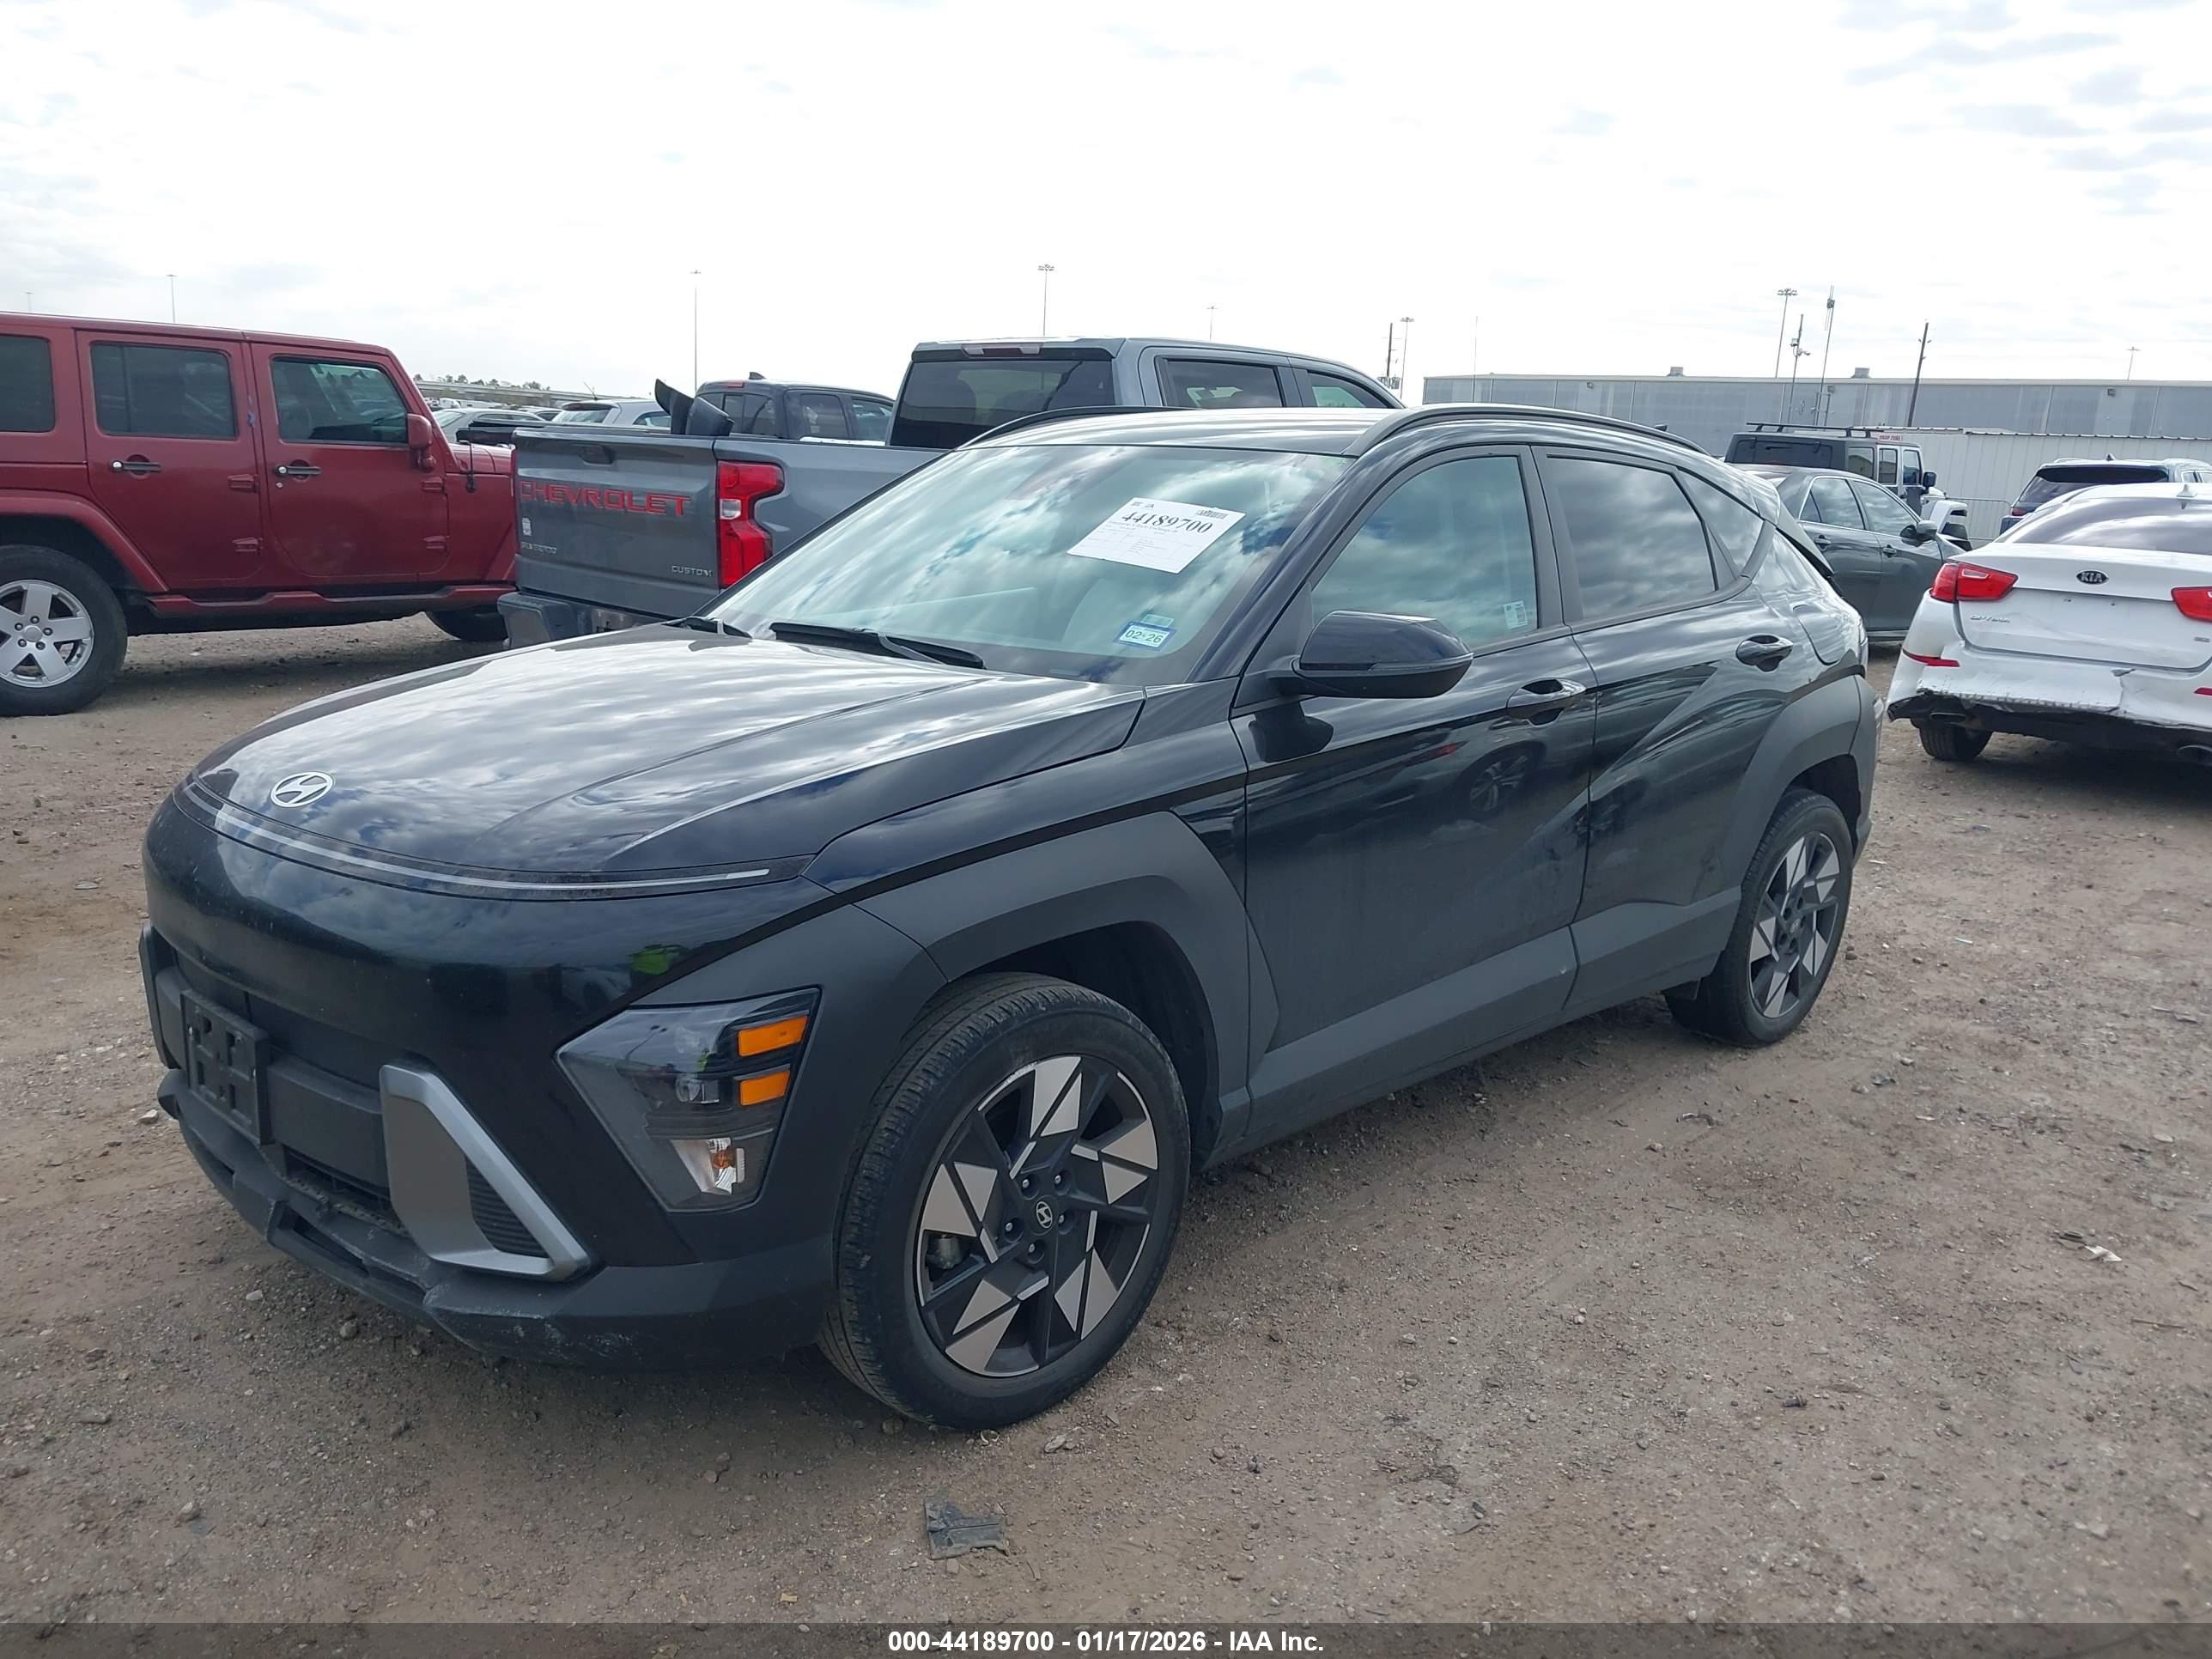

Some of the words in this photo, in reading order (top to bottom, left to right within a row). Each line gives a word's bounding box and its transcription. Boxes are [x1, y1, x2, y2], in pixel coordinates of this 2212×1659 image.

[519, 480, 691, 516] CHEVROLET
[1121, 511, 1213, 533] 44189700
[672, 565, 714, 577] CUSTOM
[2081, 571, 2103, 583] KIA
